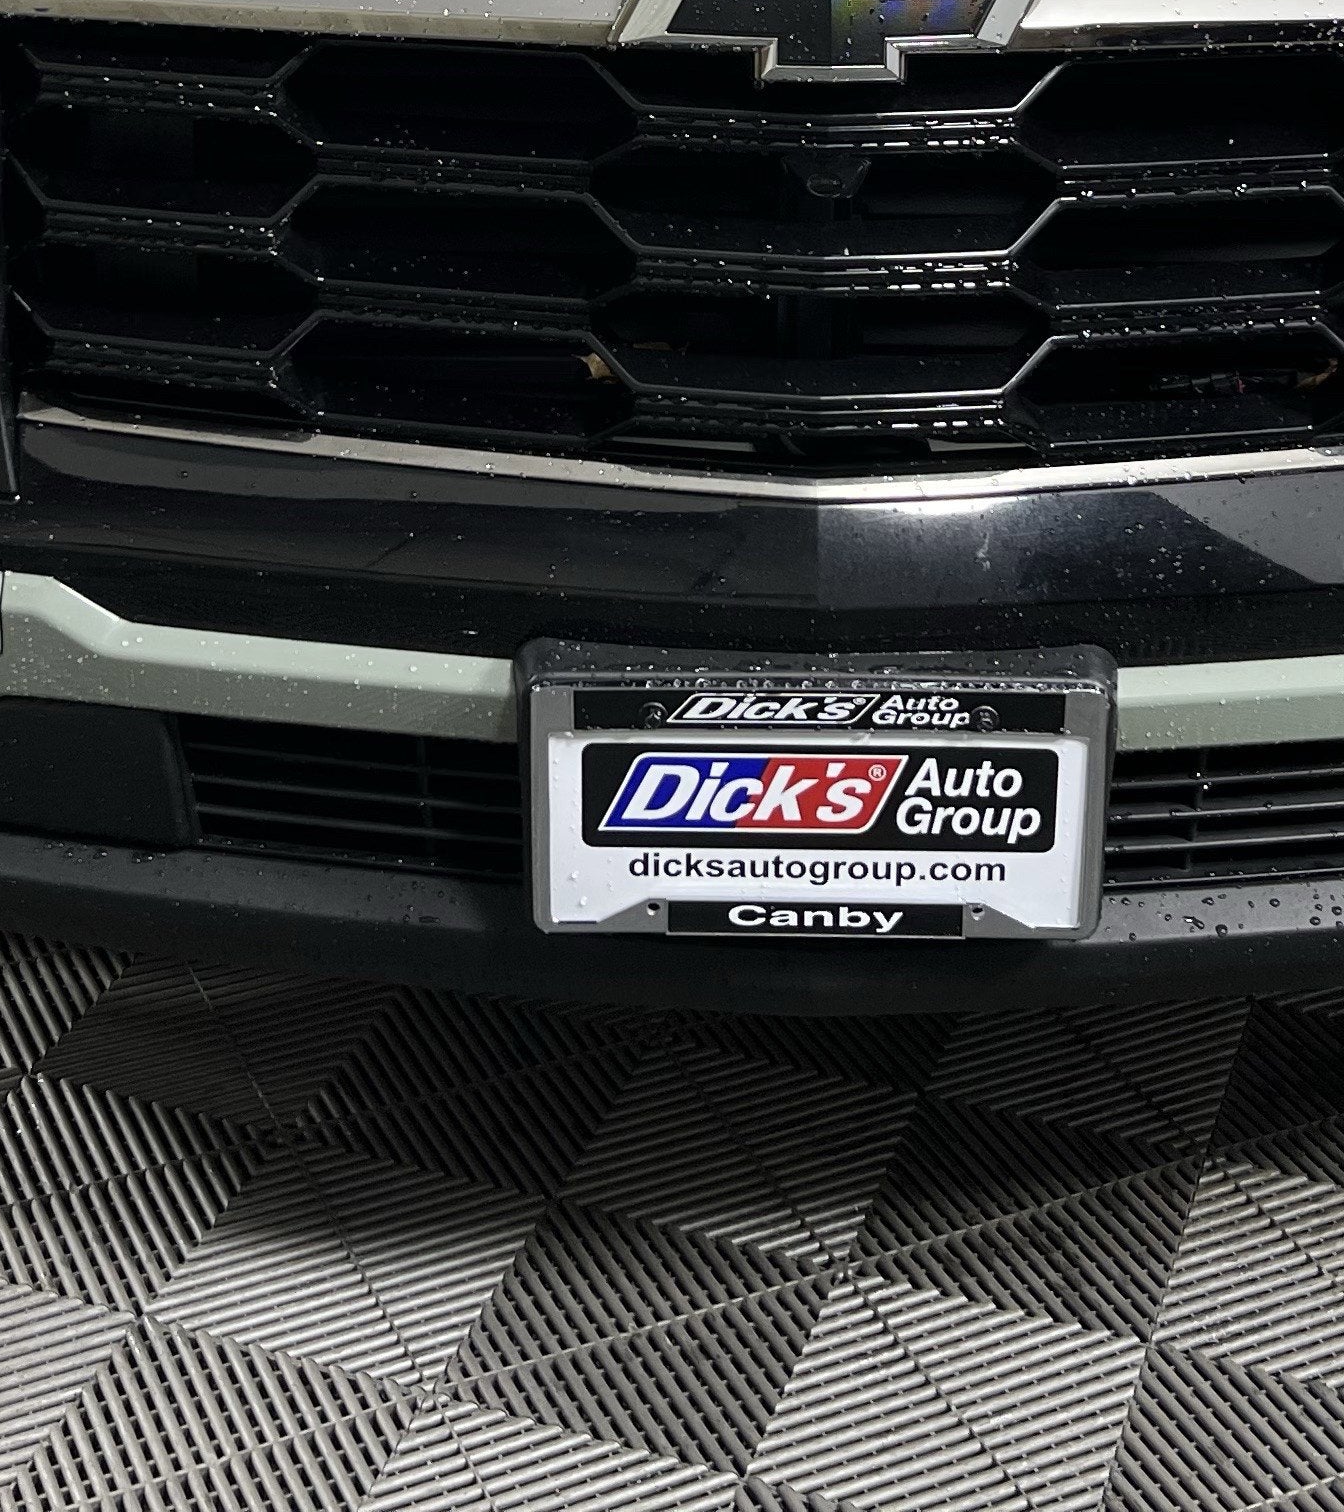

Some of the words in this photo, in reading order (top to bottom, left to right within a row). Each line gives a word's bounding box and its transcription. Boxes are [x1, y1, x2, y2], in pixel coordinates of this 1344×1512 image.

[682, 694, 855, 720] Dick's
[880, 694, 960, 711] Auto
[871, 709, 971, 728] Group
[621, 761, 872, 823] Dick's
[904, 759, 1023, 798] Auto
[896, 799, 1042, 843] Group
[629, 854, 1007, 886] dicksautogroup.com
[728, 905, 903, 933] Canby
